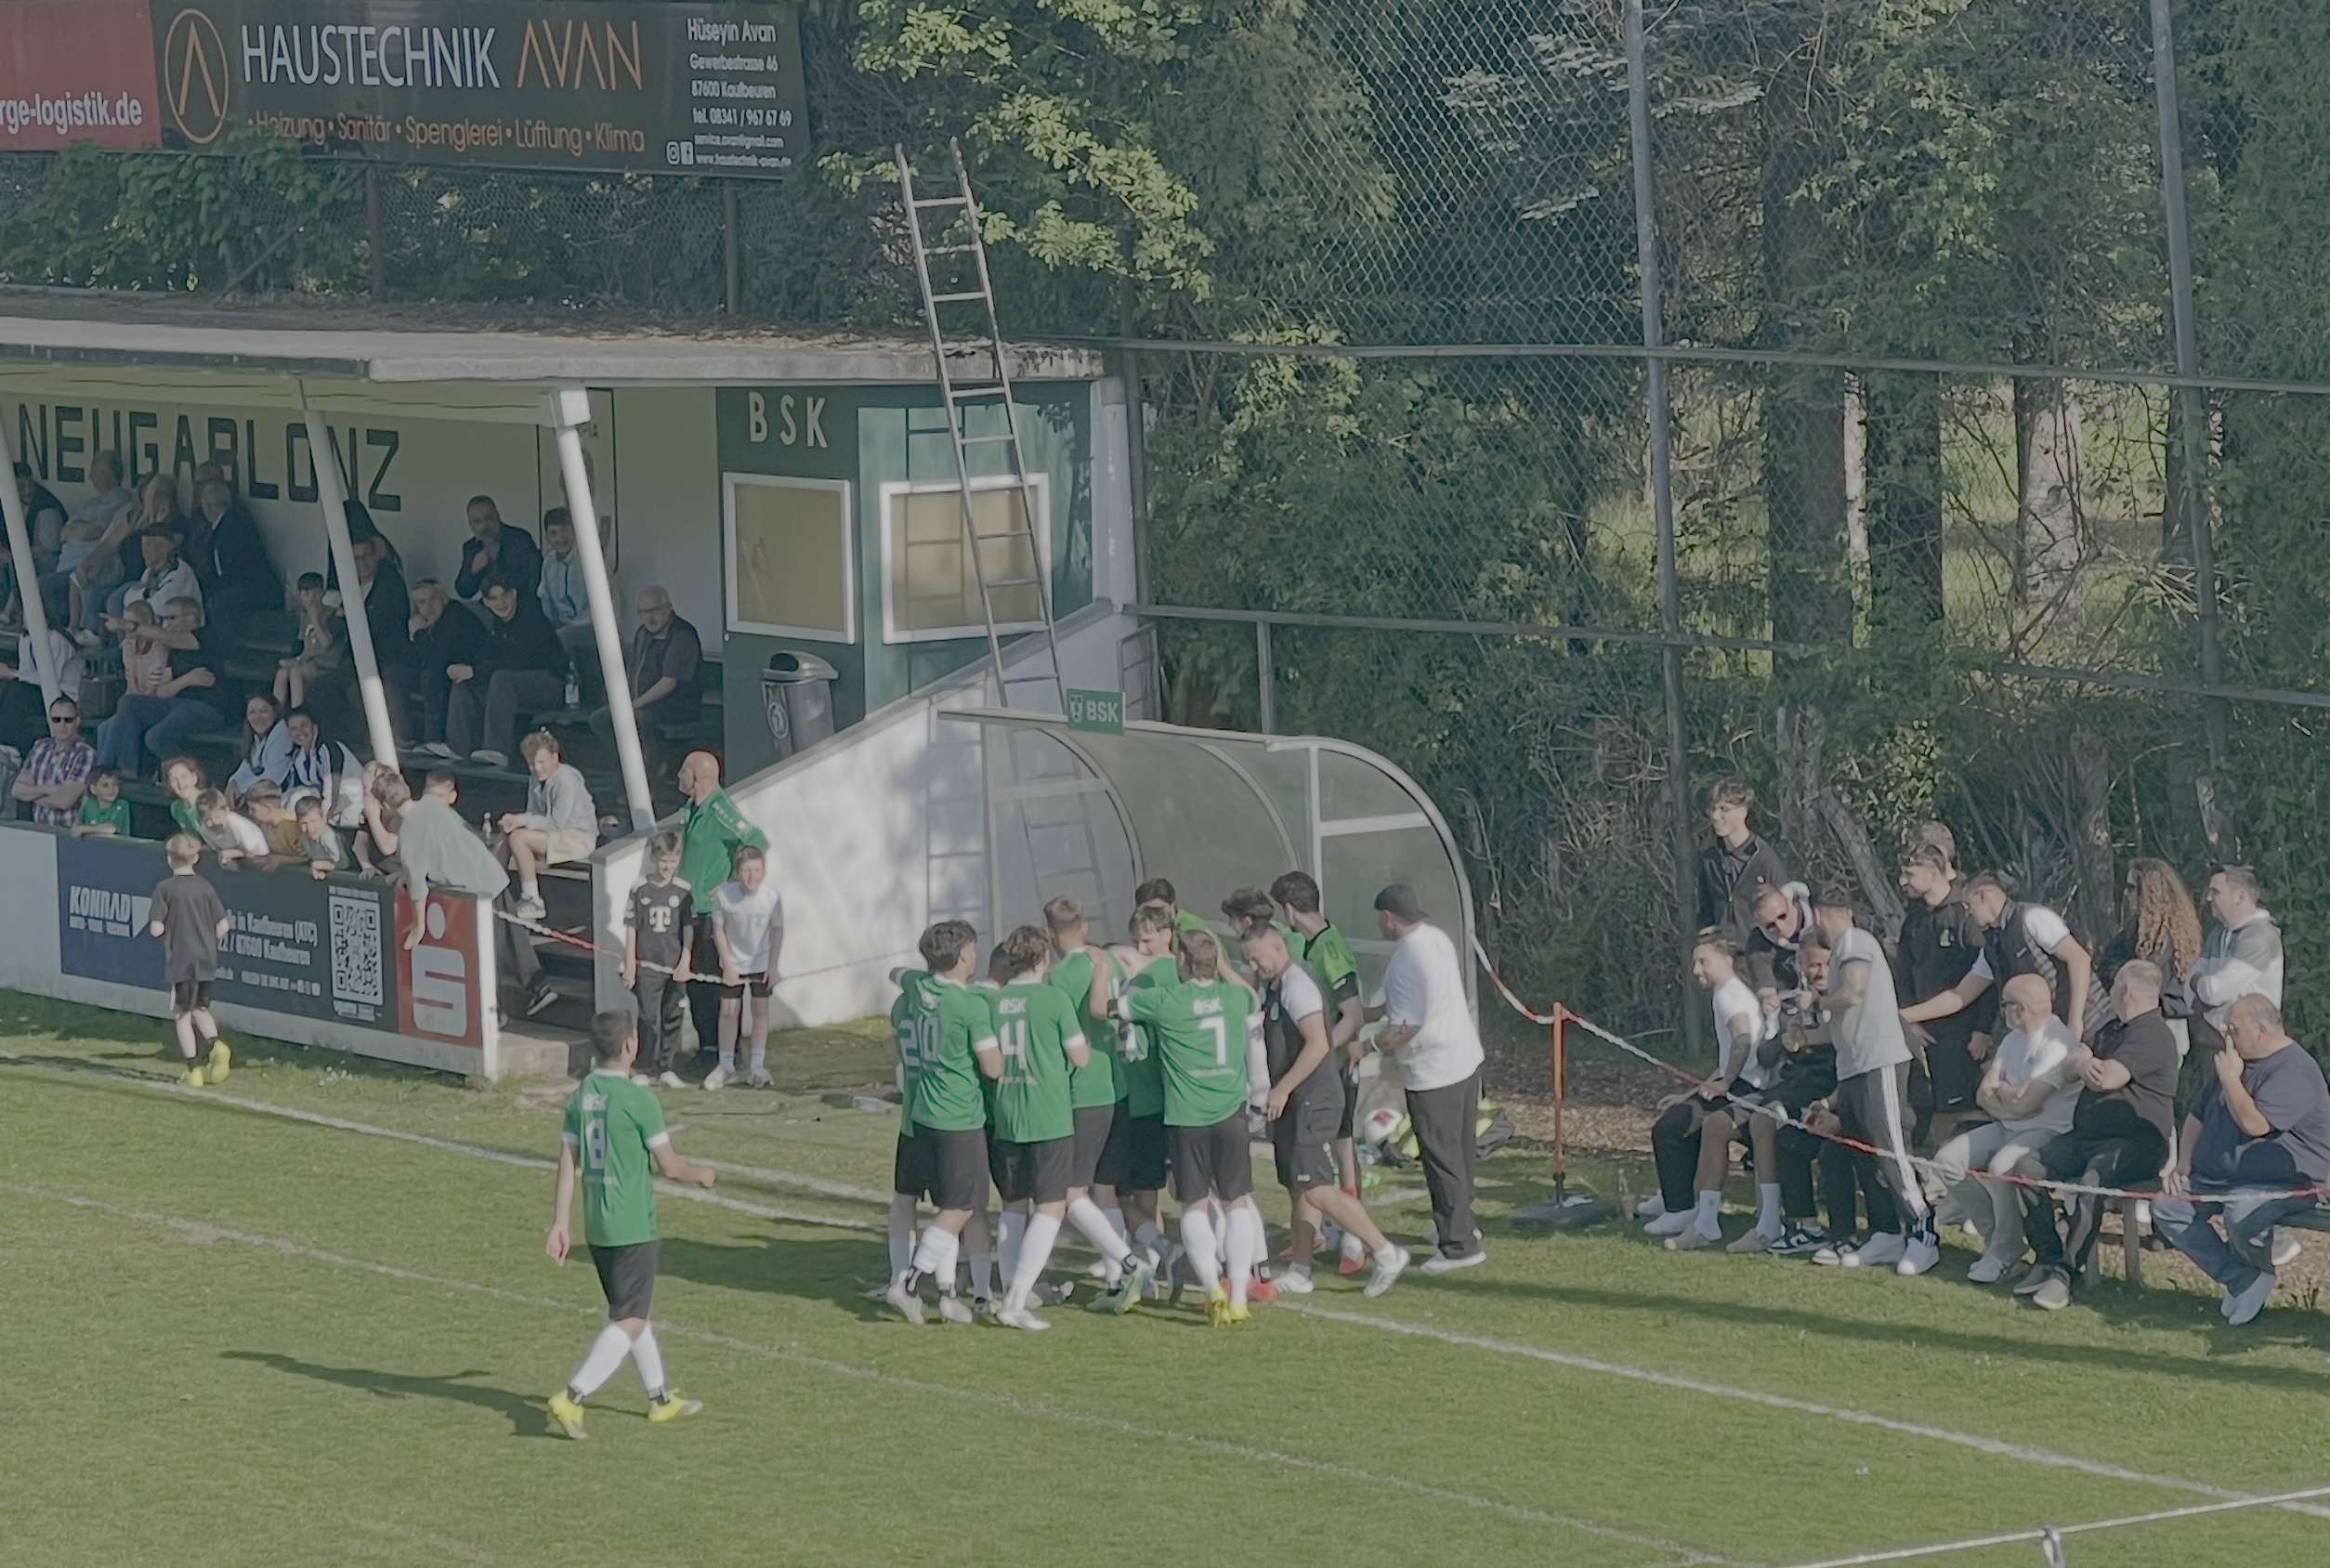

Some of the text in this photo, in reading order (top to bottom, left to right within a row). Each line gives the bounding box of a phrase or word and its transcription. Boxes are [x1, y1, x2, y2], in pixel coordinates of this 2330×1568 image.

[687, 18, 777, 46] Hüseyin Avan
[242, 19, 644, 90] HAUSTECHNIK AVAN
[691, 80, 777, 98] 87600 Kaufbeuren
[337, 111, 392, 142] Sanitär
[405, 115, 504, 152] Spenglerei
[516, 118, 582, 157] Lüftung
[594, 122, 646, 153] Klima
[1086, 699, 1120, 725] BSK
[69, 884, 131, 922] KONRAD
[1000, 1019, 1026, 1071] 4
